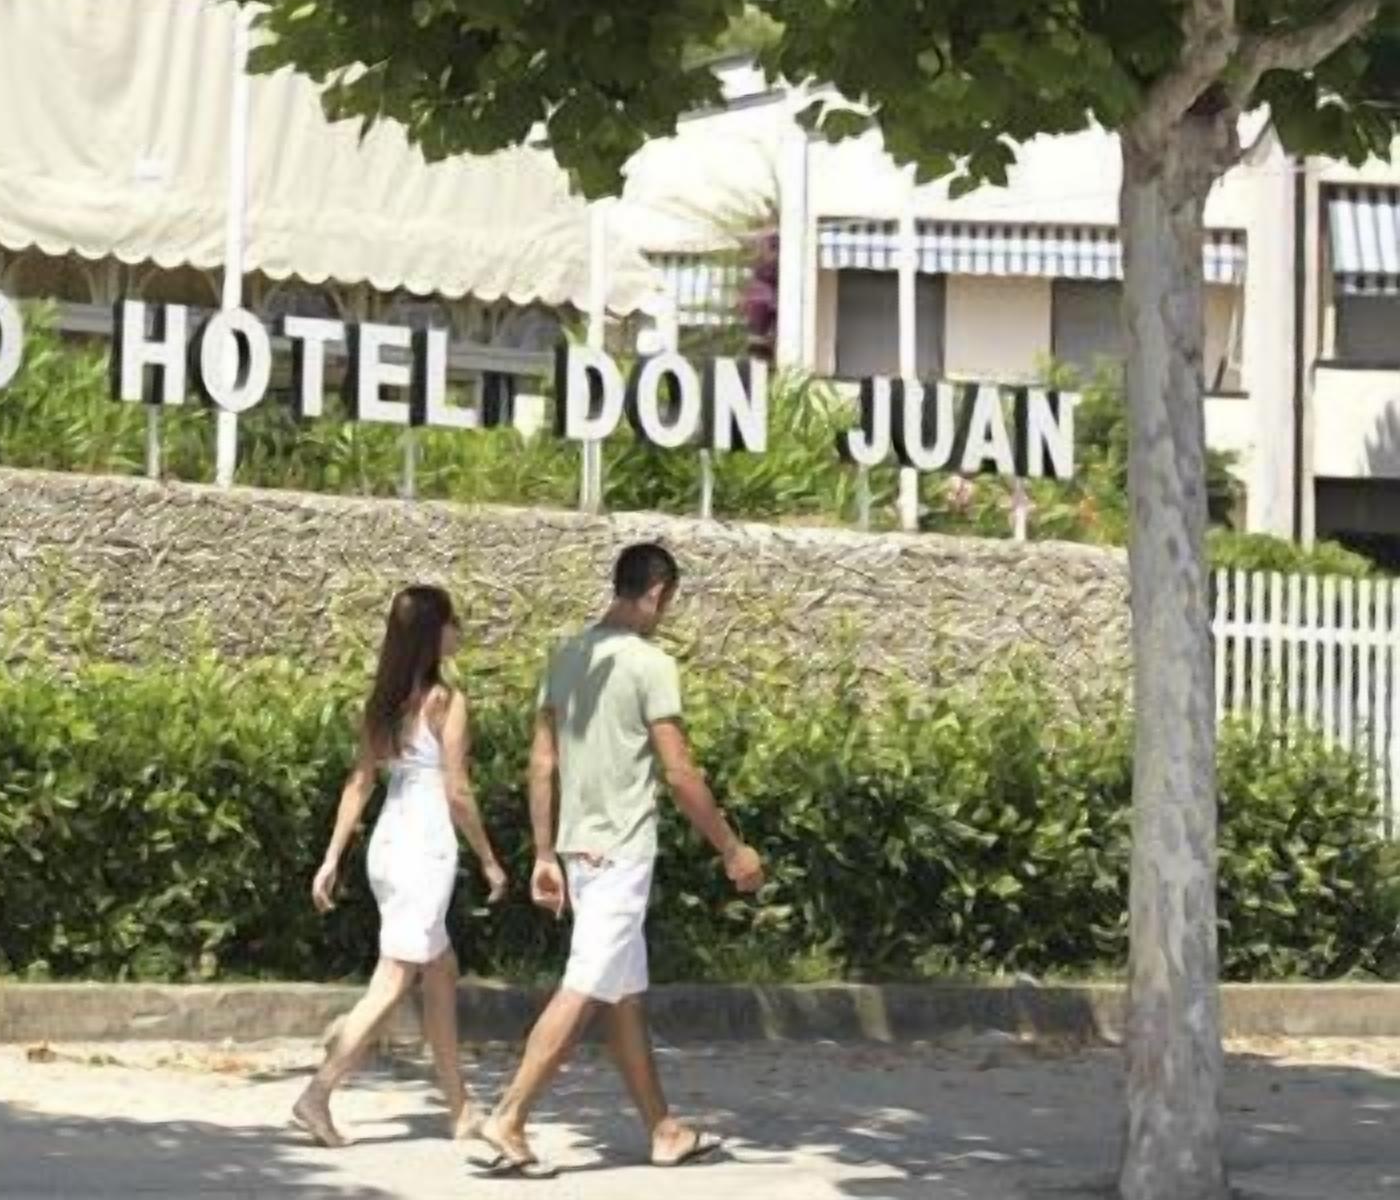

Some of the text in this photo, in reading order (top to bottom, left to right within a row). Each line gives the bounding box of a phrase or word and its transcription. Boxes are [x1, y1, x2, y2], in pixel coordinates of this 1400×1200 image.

[120, 299, 480, 429] HOTEL
[563, 345, 769, 453] DON
[846, 376, 1082, 480] JUAN
